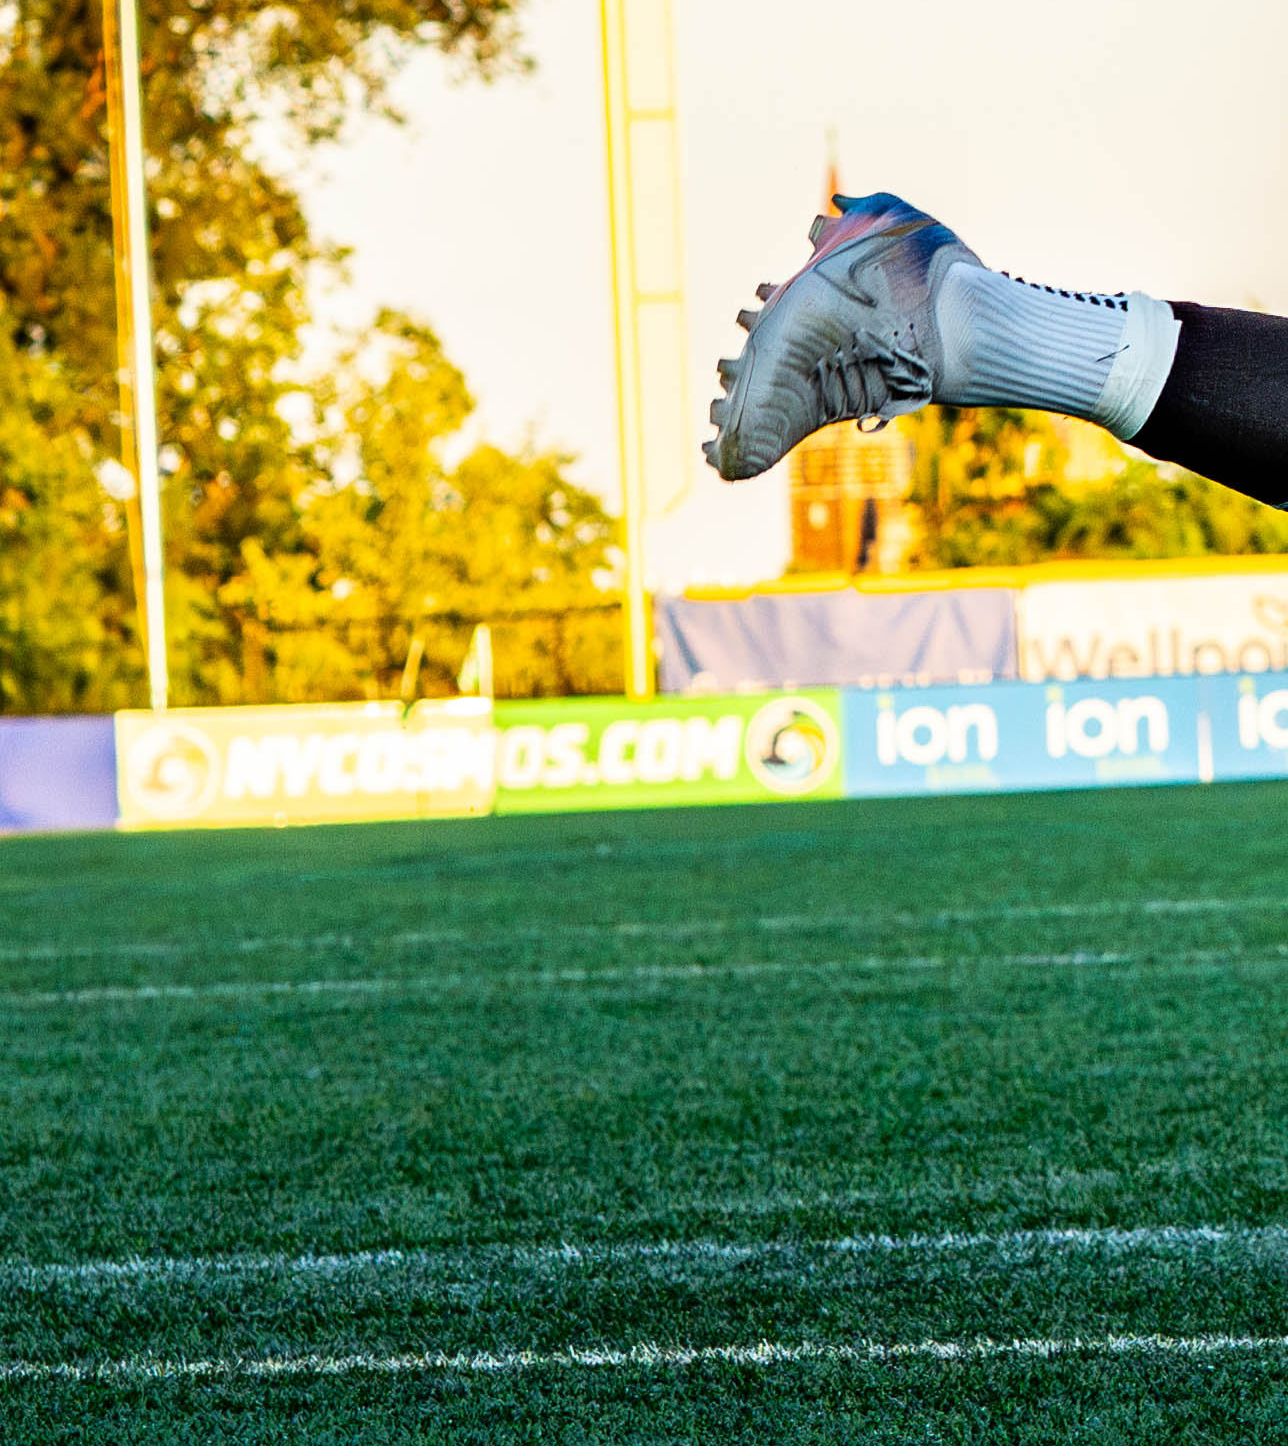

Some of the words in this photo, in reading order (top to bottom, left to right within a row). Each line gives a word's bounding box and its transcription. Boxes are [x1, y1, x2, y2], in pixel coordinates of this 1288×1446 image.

[224, 715, 744, 798] NYCOSMOS.COM
[876, 692, 998, 766] ion
[1045, 685, 1170, 758] ion
